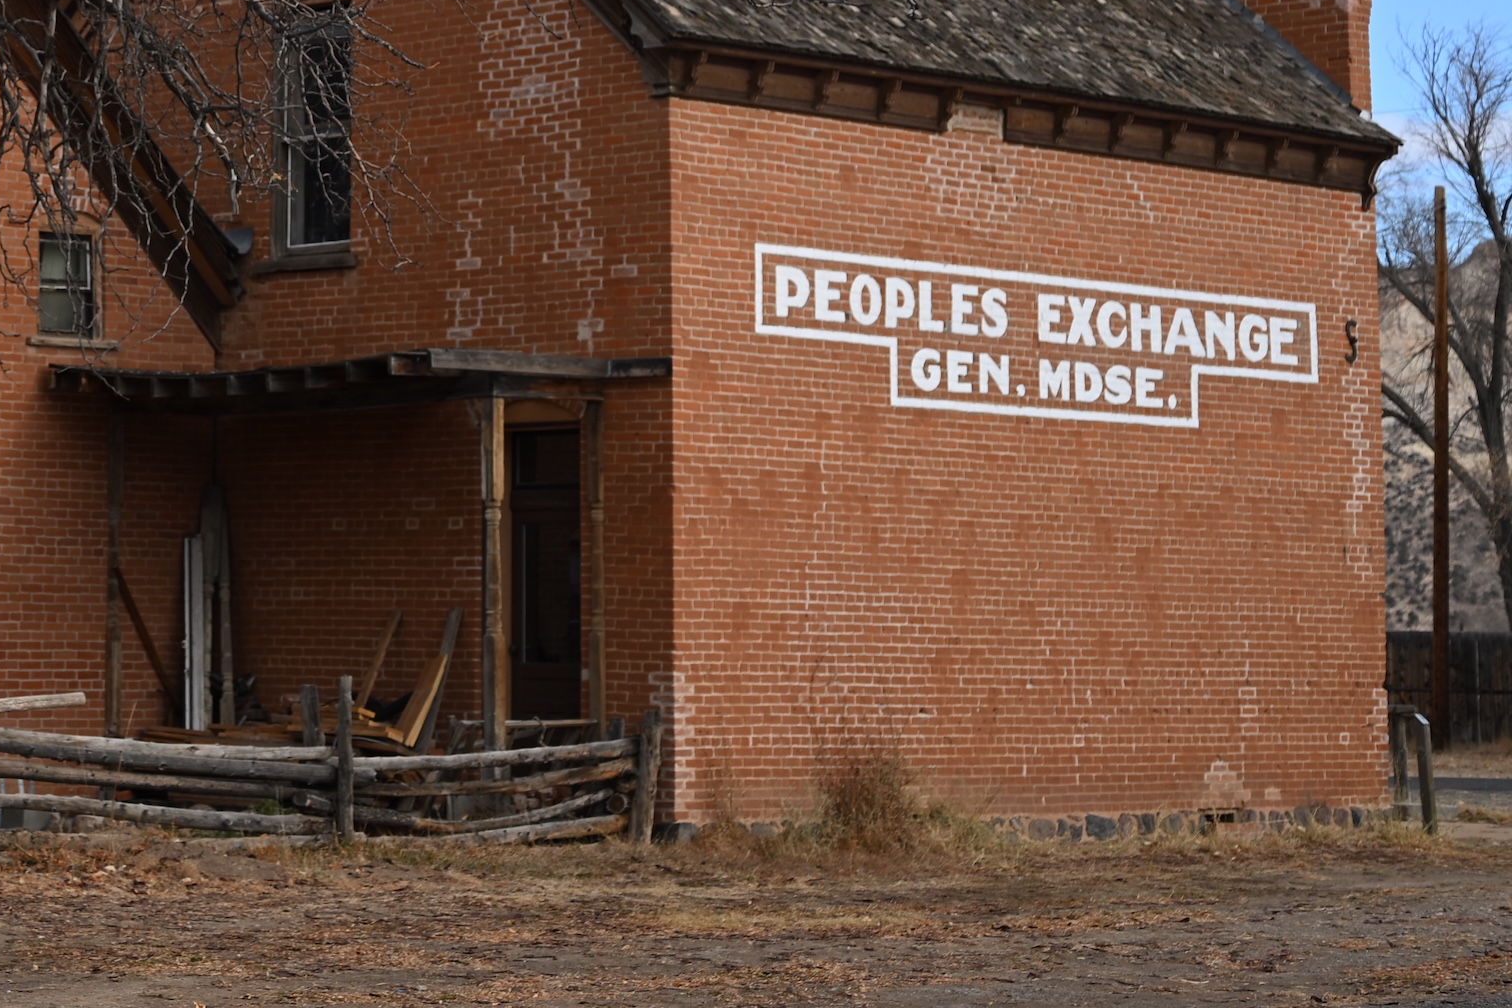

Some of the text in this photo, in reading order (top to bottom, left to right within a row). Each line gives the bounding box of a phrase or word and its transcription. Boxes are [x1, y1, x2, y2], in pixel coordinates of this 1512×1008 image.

[774, 264, 1299, 366] PEOPLES EXCHANGE
[1038, 358, 1177, 410] MDSE.
